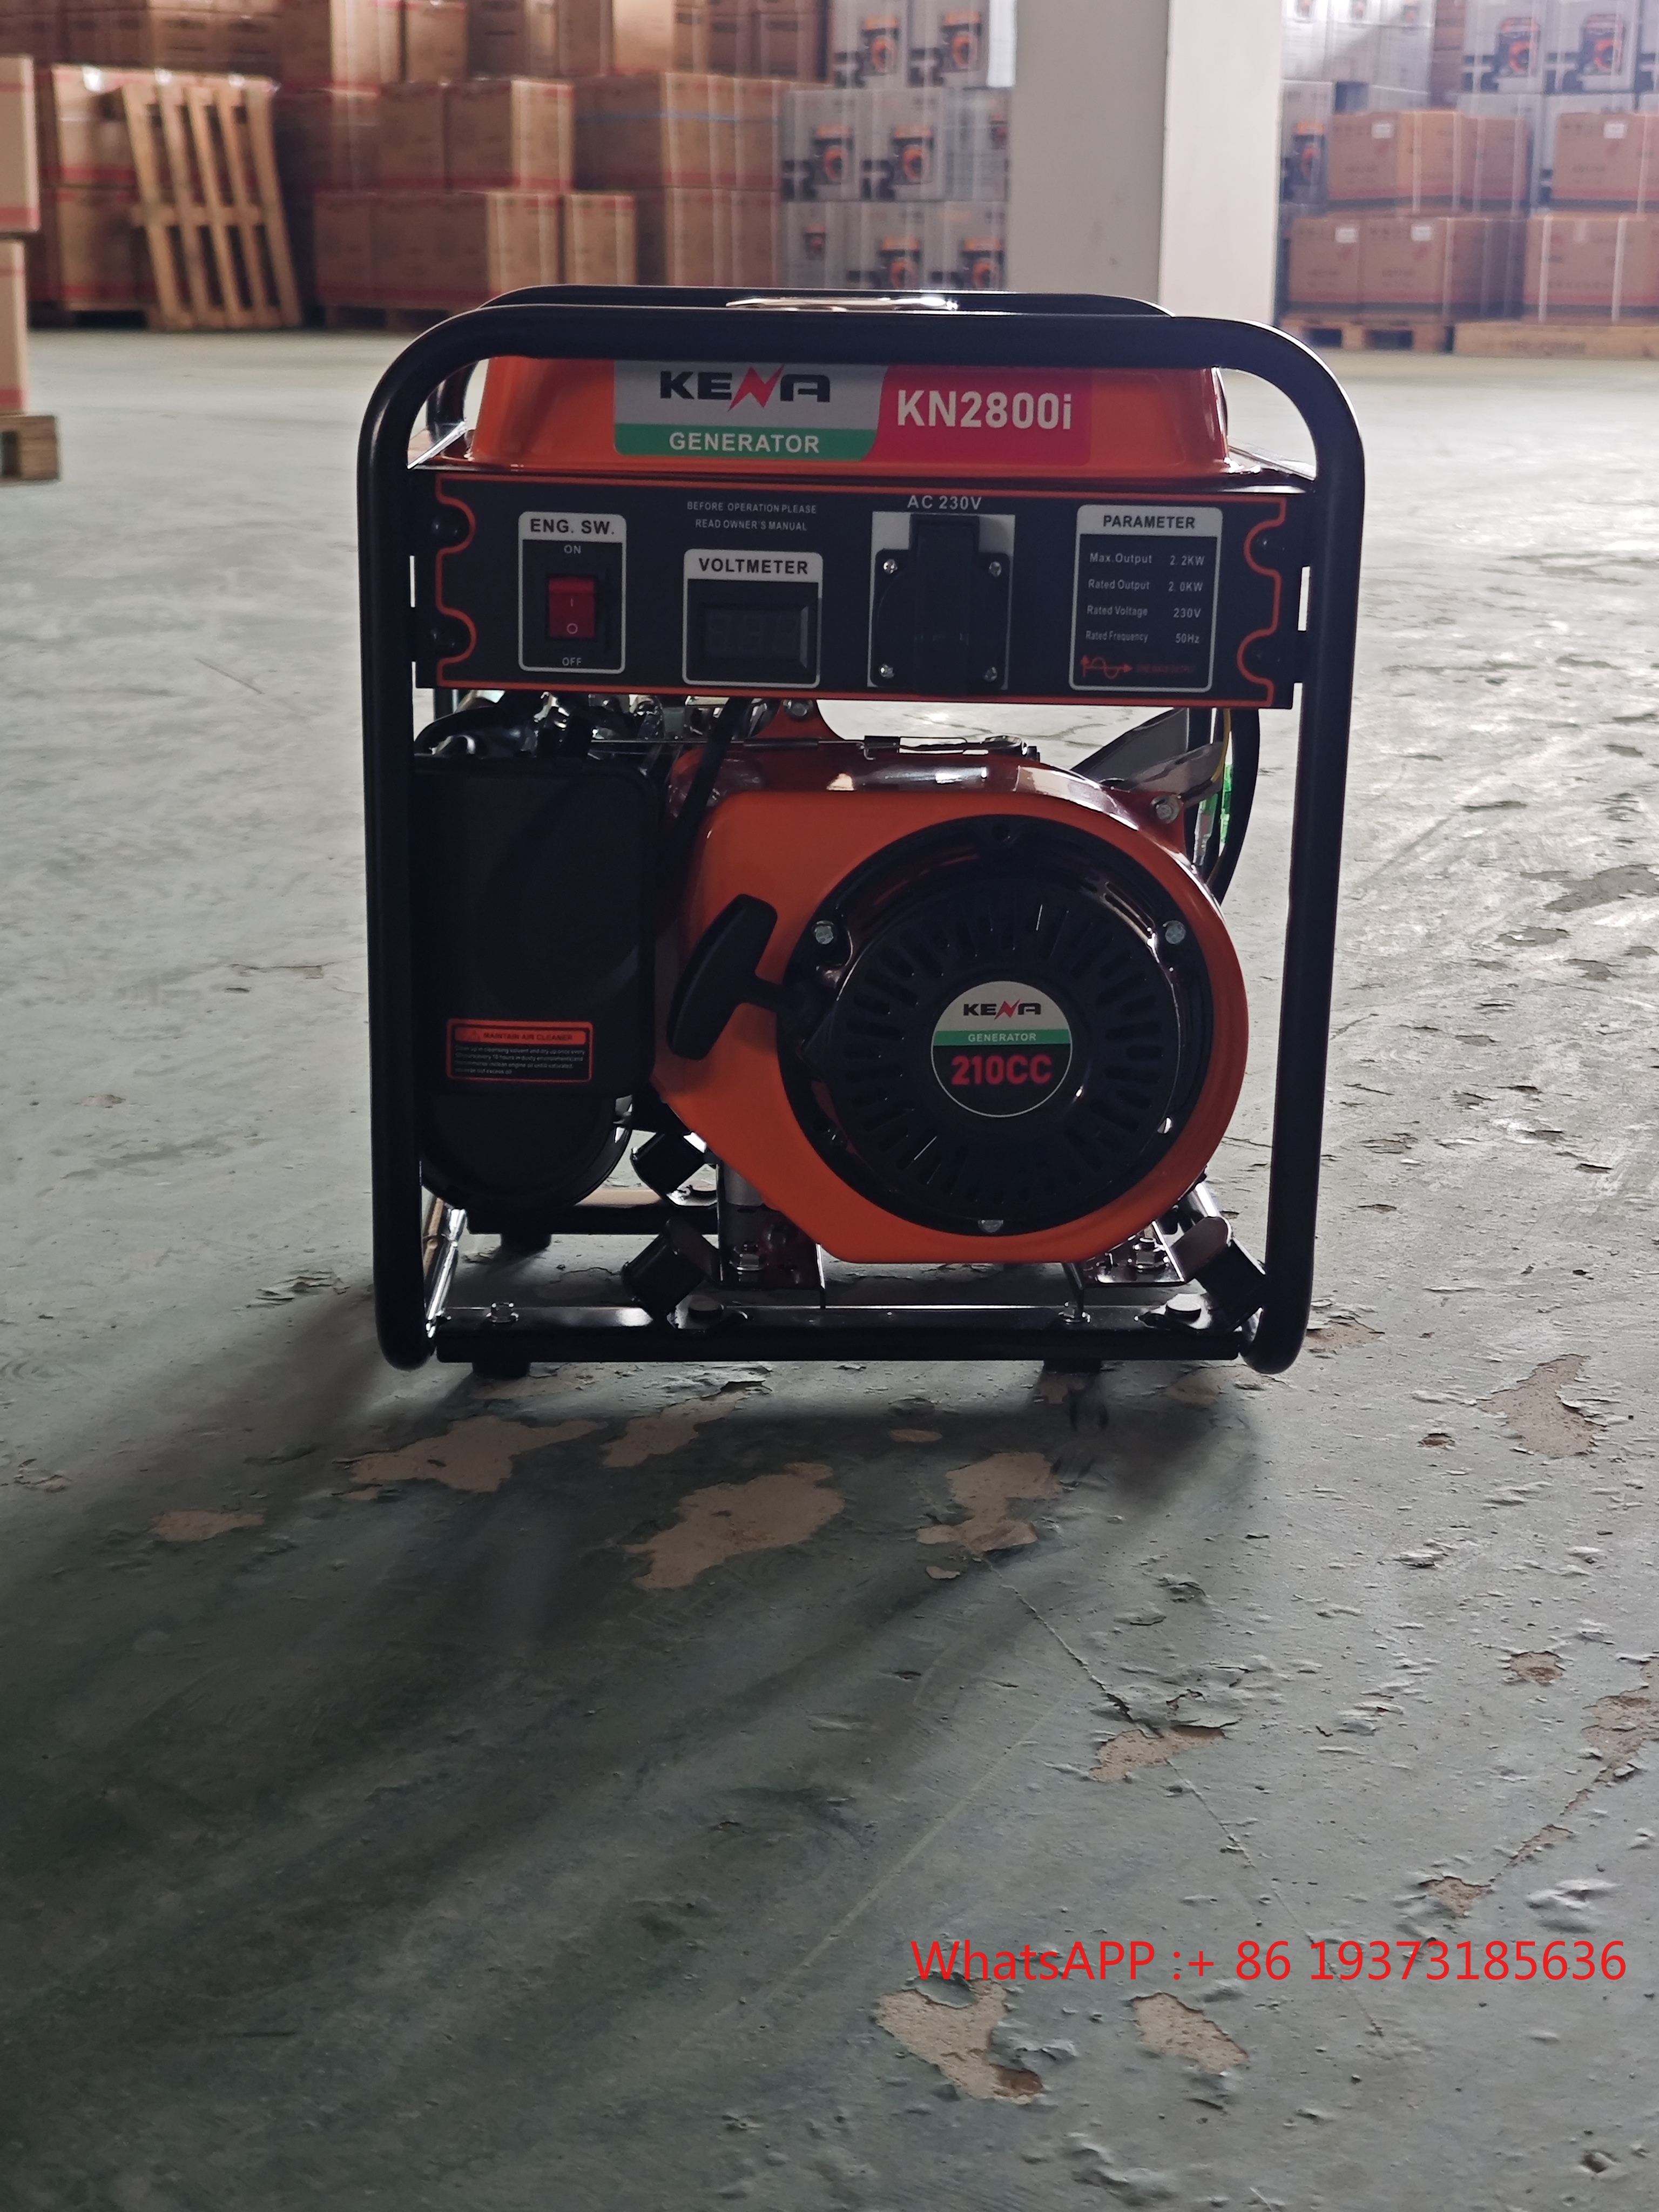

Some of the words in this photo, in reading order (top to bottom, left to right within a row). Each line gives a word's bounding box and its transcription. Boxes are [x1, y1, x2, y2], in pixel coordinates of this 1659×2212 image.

[659, 365, 830, 411] KENA
[898, 390, 1071, 429] KN2800i
[670, 432, 819, 453] GENERATOR
[687, 501, 723, 510] BEFORE
[728, 503, 779, 512] OPERATION
[782, 504, 816, 514] PLEASE
[907, 495, 934, 509] AC
[939, 495, 982, 510] 230V
[531, 518, 573, 533] ENG.
[582, 520, 613, 534] SW.
[696, 519, 720, 528] READ
[723, 520, 766, 529] OWNER'S
[768, 521, 806, 530] MANUAL
[1103, 515, 1195, 529] PARAMETER
[564, 545, 581, 554] ON
[699, 558, 807, 574] VOLTMETER
[1089, 579, 1115, 589] Rated
[1118, 579, 1149, 591] Output
[1087, 605, 1112, 615] Rated
[1115, 606, 1148, 618] Voltage
[1174, 608, 1201, 618] 230V
[1086, 631, 1107, 640] Rated
[1109, 631, 1148, 643] Frequency
[1176, 633, 1199, 643] 50Hz
[562, 657, 582, 667] OFF
[963, 1000, 1041, 1019] KENA
[968, 1033, 1036, 1042] GENERATOR
[953, 1055, 1051, 1085] 210CC
